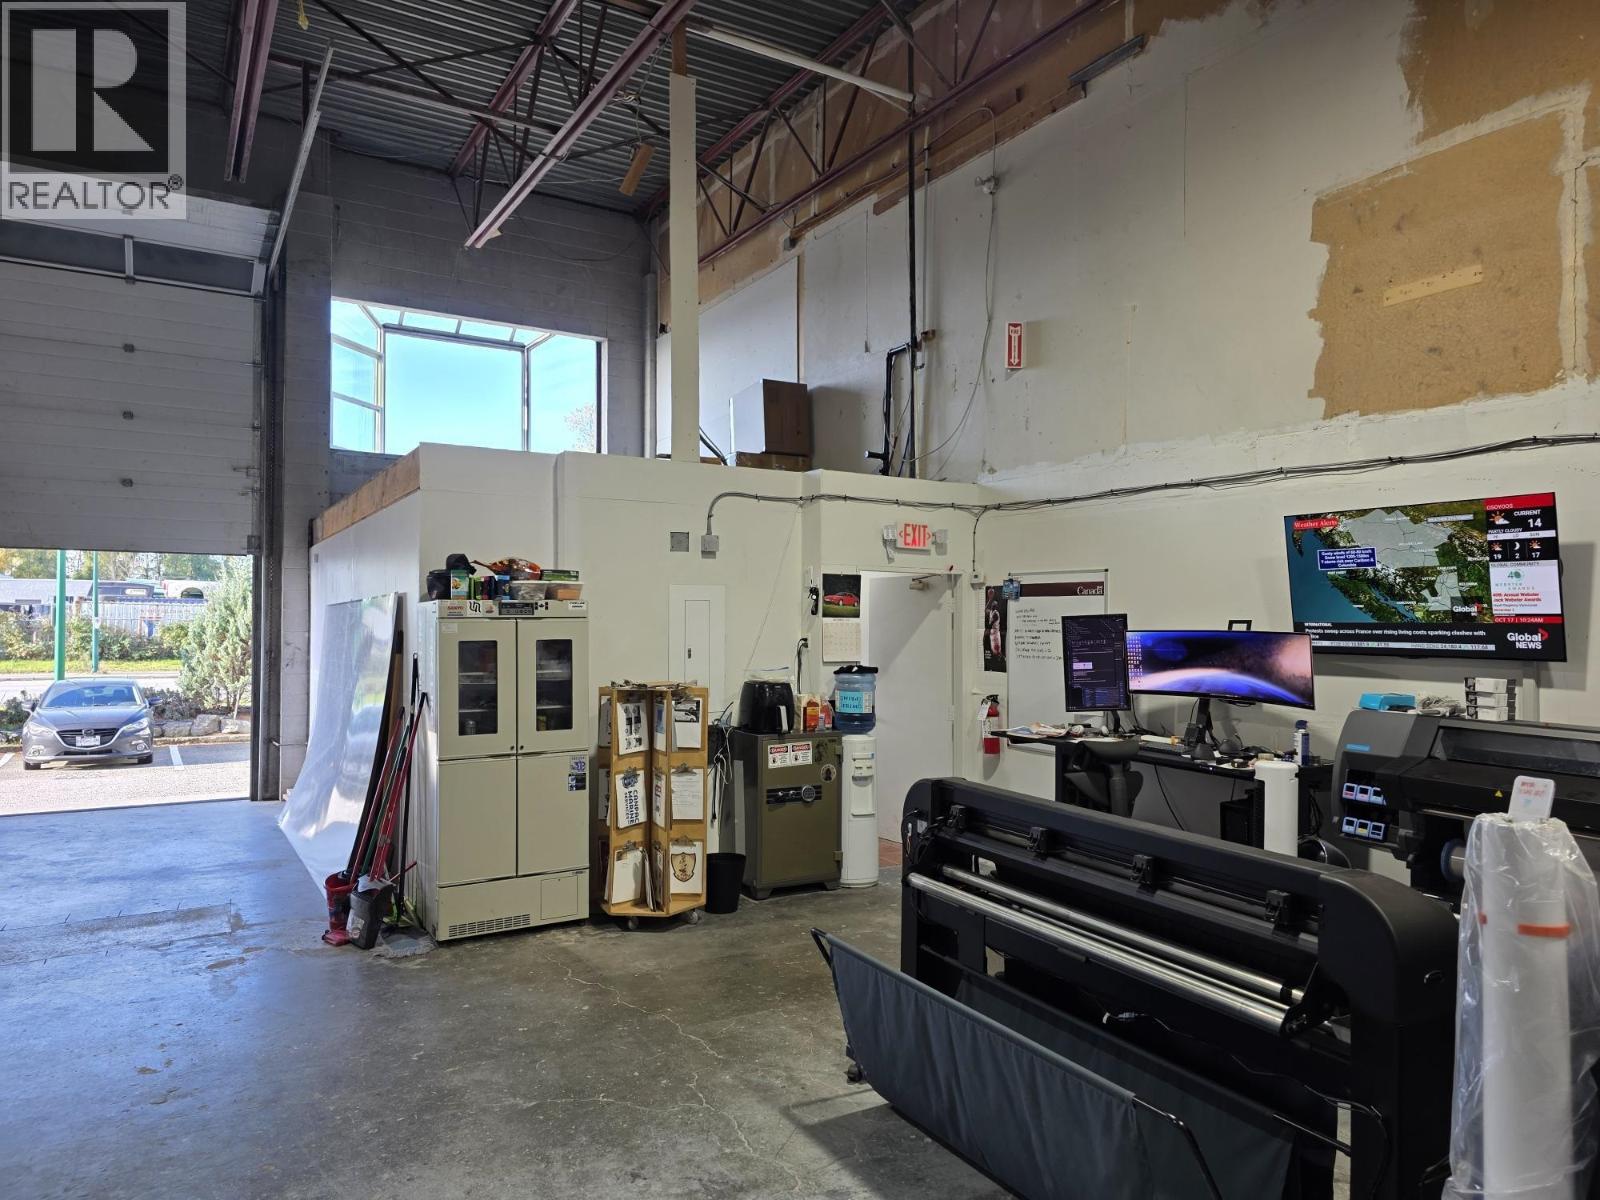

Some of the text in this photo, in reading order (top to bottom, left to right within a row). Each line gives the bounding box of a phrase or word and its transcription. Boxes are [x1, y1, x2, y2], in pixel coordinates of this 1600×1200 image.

[1513, 509, 1541, 517] CURRENT
[1294, 519, 1338, 529] Weather Alerts
[1527, 518, 1543, 528] 14
[903, 523, 928, 547] EXIT
[1531, 551, 1541, 559] 17
[1076, 585, 1103, 596] Canada
[1452, 604, 1478, 613] Global
[1506, 631, 1542, 642] Global
[1515, 641, 1543, 650] NEWS
[627, 790, 635, 824] MARINE
